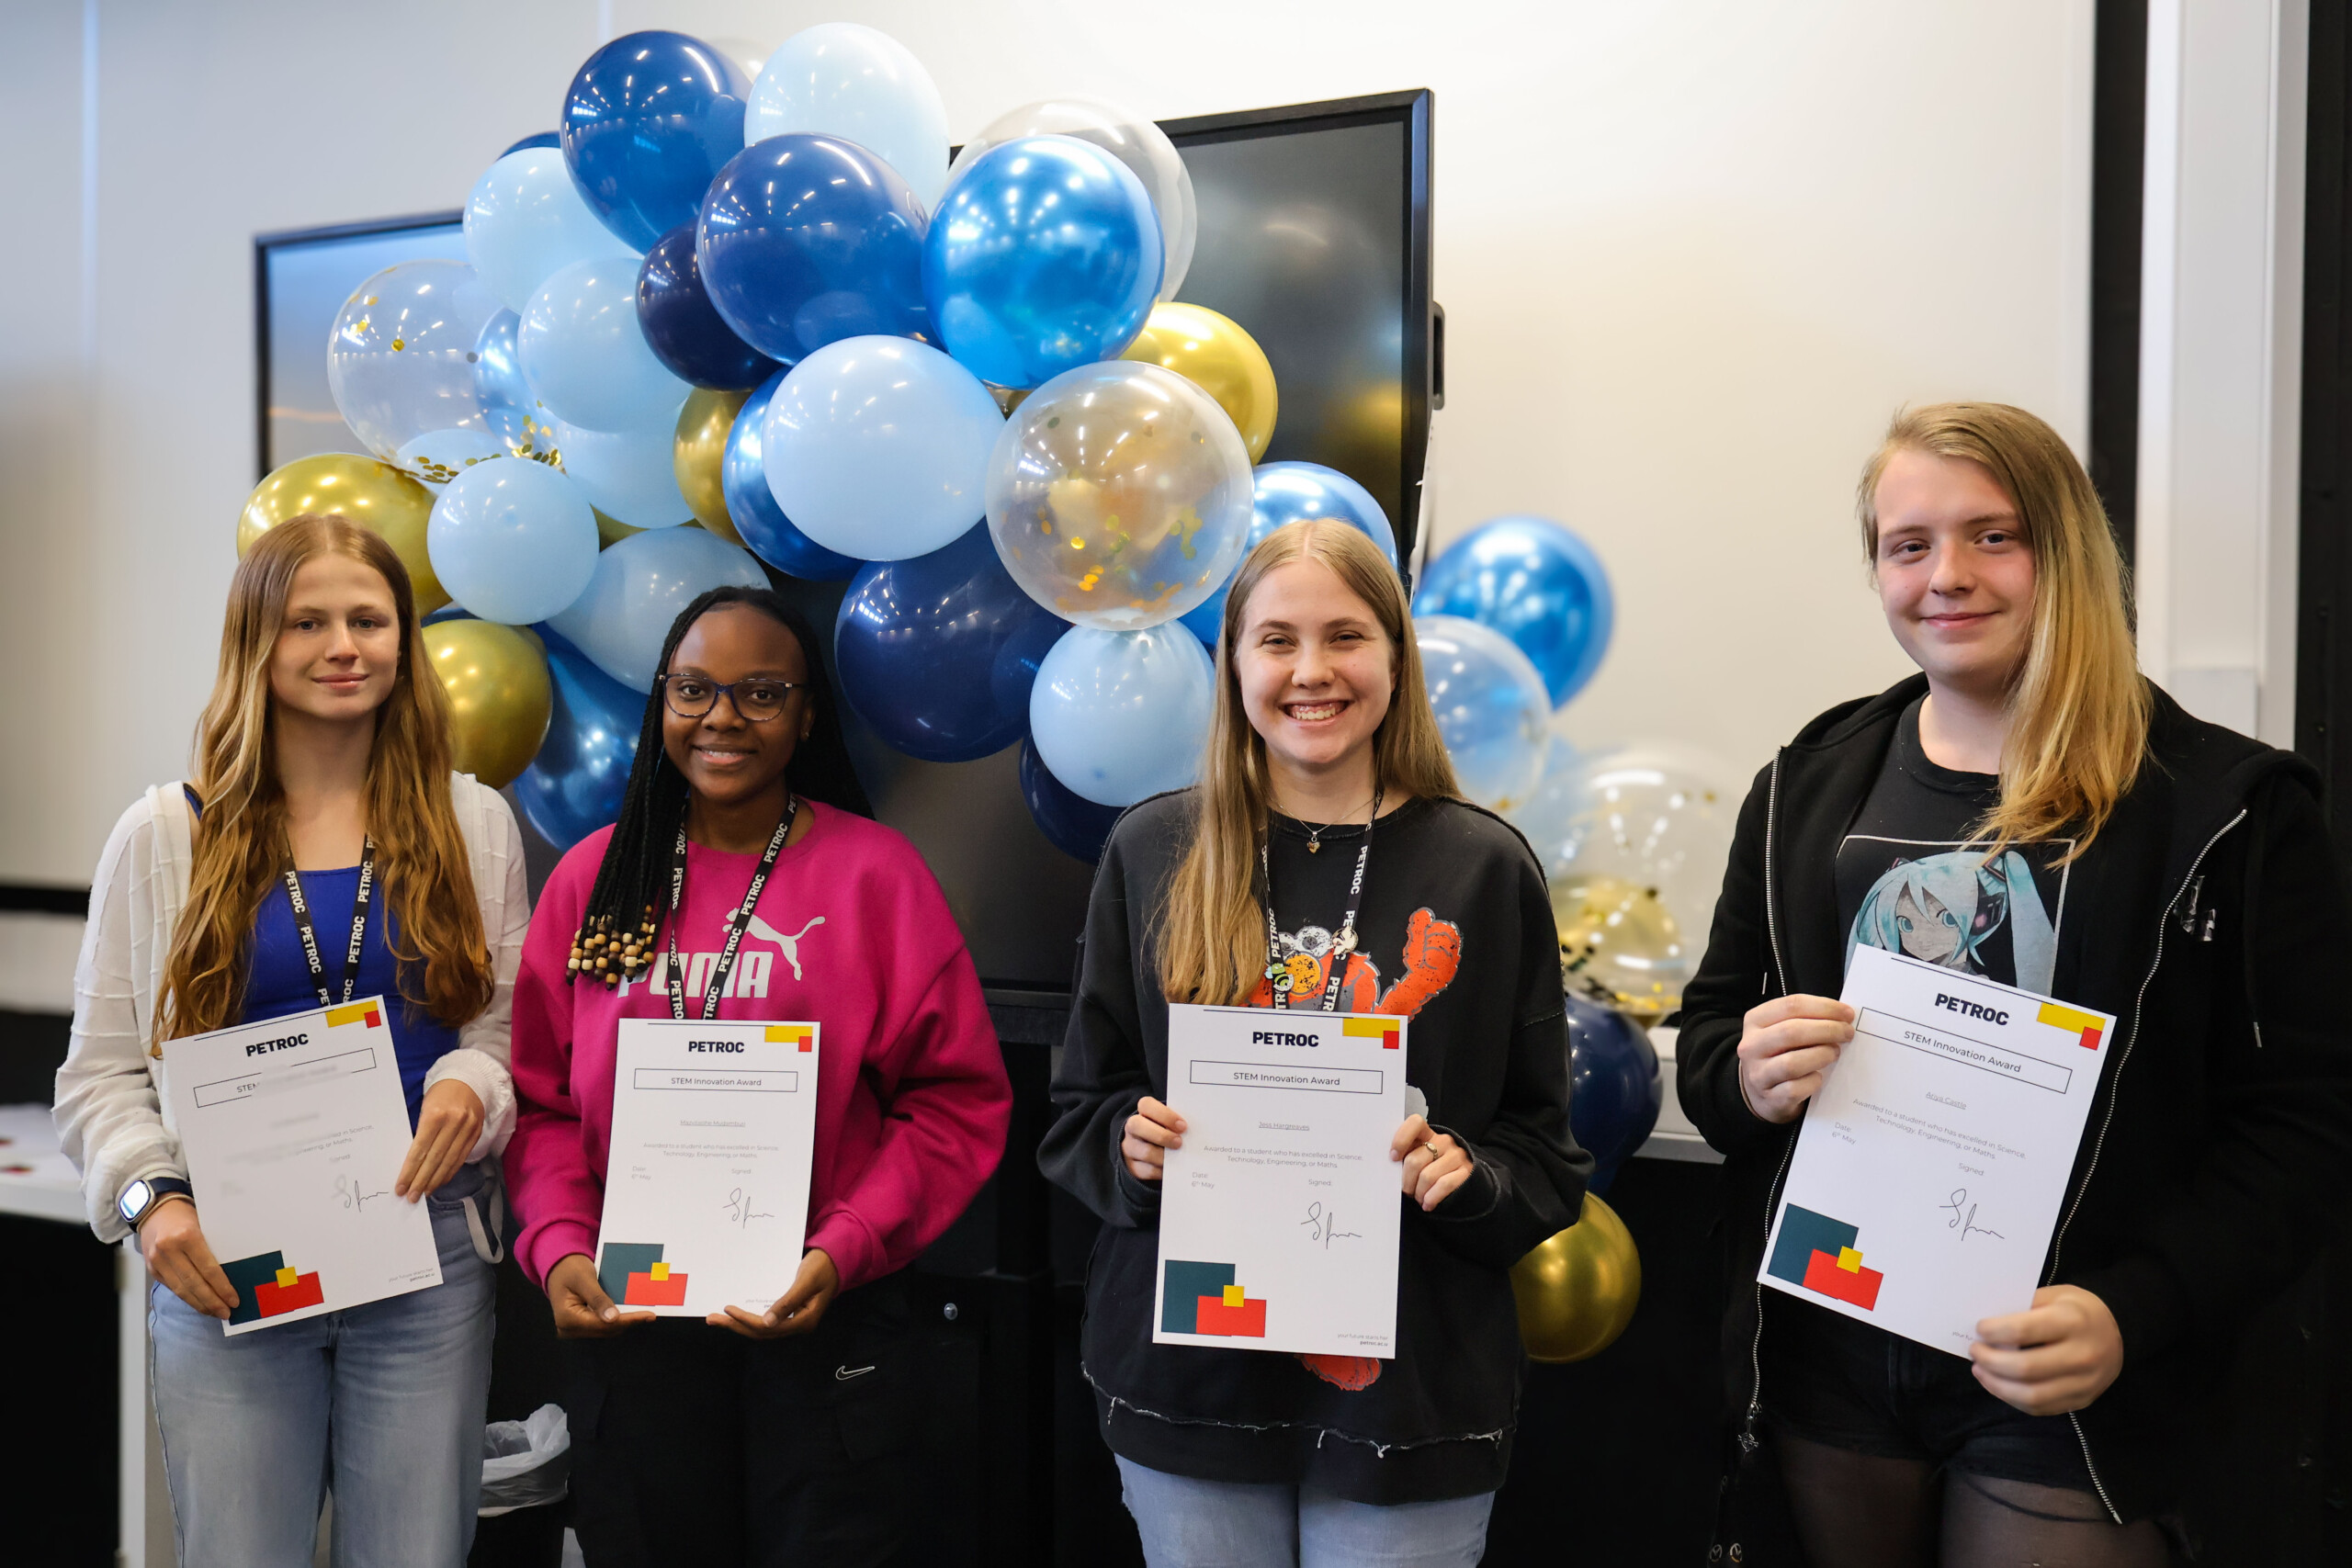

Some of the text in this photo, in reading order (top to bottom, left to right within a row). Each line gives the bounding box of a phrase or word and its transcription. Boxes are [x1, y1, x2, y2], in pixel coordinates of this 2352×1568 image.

[675, 829, 685, 855] ROC
[763, 823, 788, 863] PETROC
[357, 861, 374, 903] PETROC
[673, 867, 684, 910] PETROC
[1351, 845, 1368, 896] PETROC
[286, 871, 305, 913] PETROC
[741, 874, 765, 916] PETROC
[300, 926, 322, 974] PETROC
[348, 916, 366, 964] PETROC
[718, 928, 742, 973] PETROC
[1268, 908, 1283, 959] PETROC
[342, 978, 354, 1003] ROC
[670, 980, 684, 1020] PETRO
[703, 986, 720, 1020] TROC
[1322, 976, 1341, 1012] PETR
[1935, 993, 2009, 1026] PETROC
[245, 1033, 310, 1057] PETROC
[688, 1041, 745, 1054] PETROC
[1252, 1032, 1319, 1047] PETROC
[1904, 1031, 2021, 1073] STEM Innovation Award
[671, 1077, 762, 1087] STEM Innovation Award
[1233, 1072, 1340, 1086] STEM Innovation Award
[1944, 1097, 1966, 1110] Castle
[1841, 1134, 1857, 1145] May
[1852, 1099, 1883, 1113] Awarded
[1885, 1108, 1892, 1116] to
[1899, 1112, 1926, 1127] student
[1927, 1122, 1943, 1132] who
[1944, 1127, 1957, 1137] has
[1958, 1132, 1987, 1146] excelled
[1988, 1141, 1996, 1149] in
[1963, 1144, 1972, 1152] or
